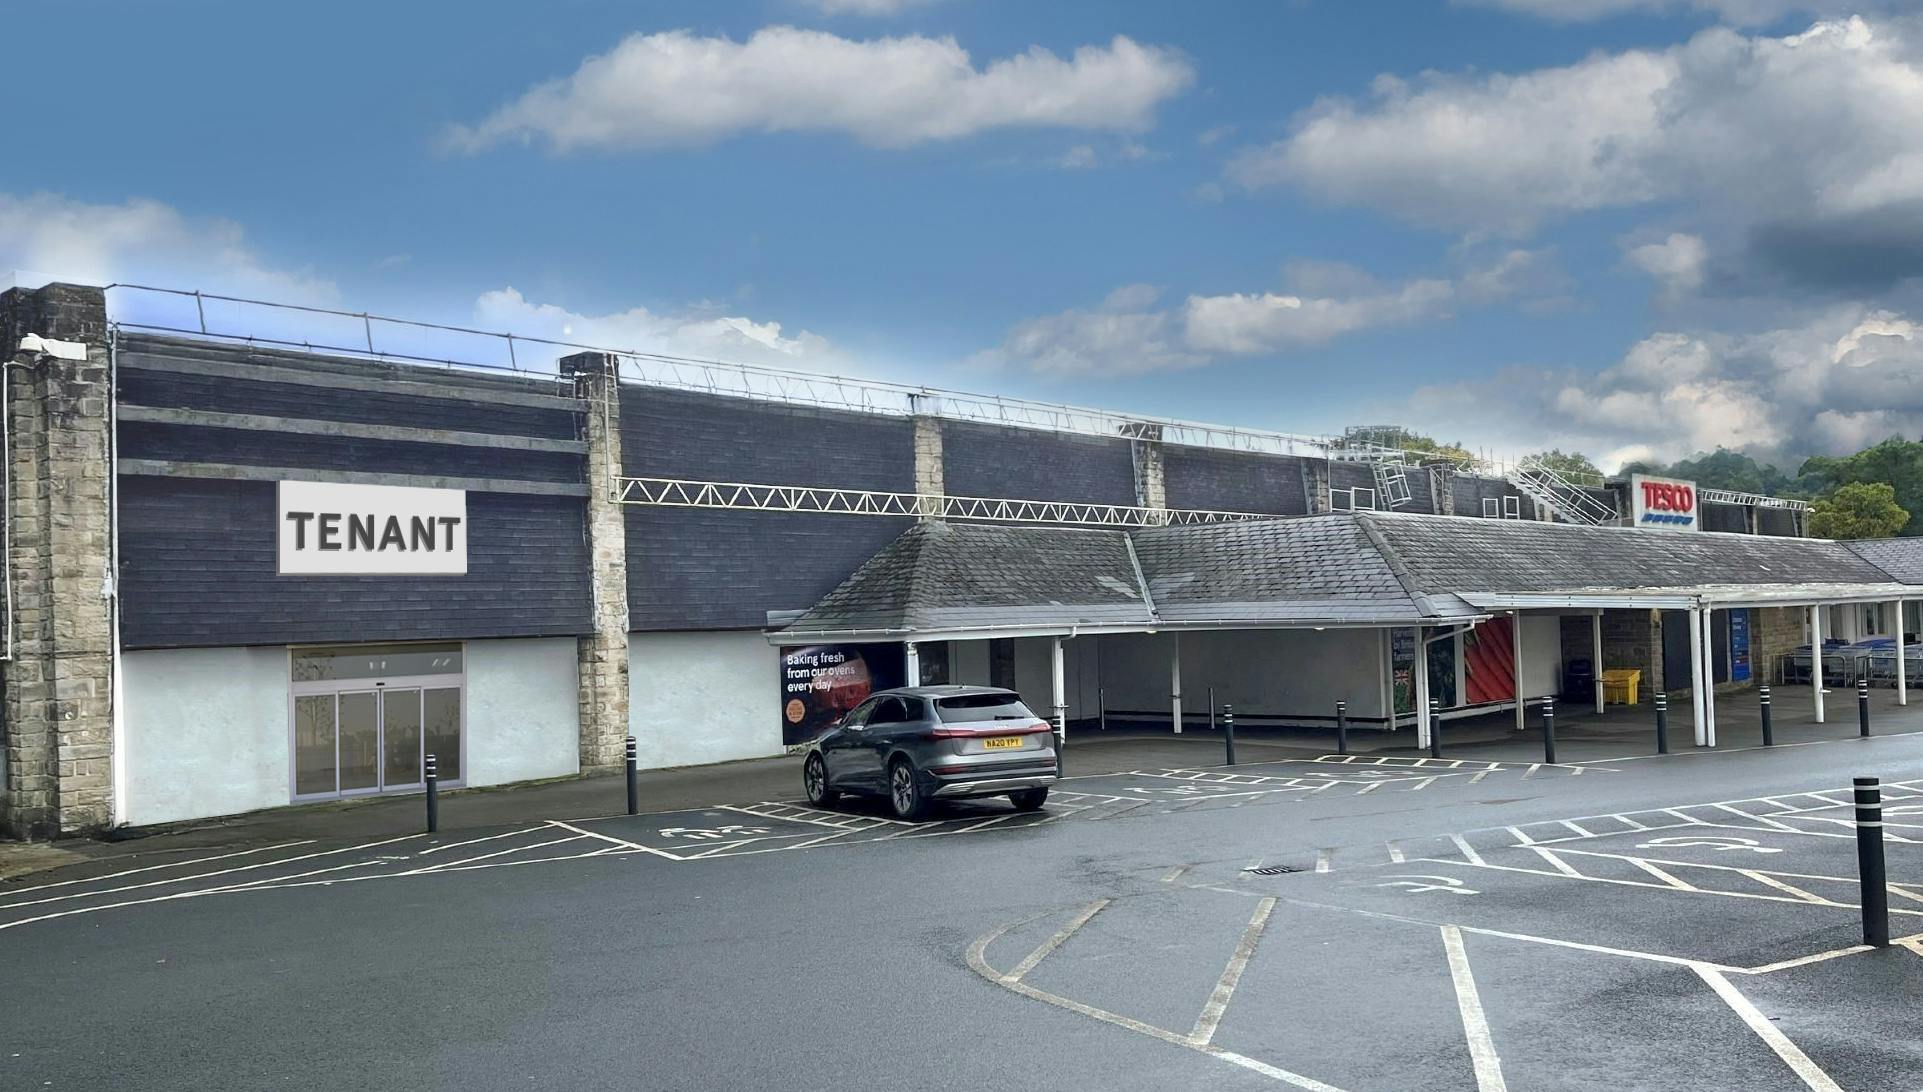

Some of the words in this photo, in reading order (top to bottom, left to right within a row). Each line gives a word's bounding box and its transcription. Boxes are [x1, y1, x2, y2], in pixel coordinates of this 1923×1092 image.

[1641, 482, 1693, 512] TESCO
[286, 511, 461, 552] TENANT
[787, 654, 818, 666] Baking
[820, 652, 845, 663] fresh
[787, 667, 810, 678] from
[811, 667, 828, 677] our
[828, 666, 855, 676] ovens
[787, 682, 813, 693] every
[815, 680, 832, 692] day
